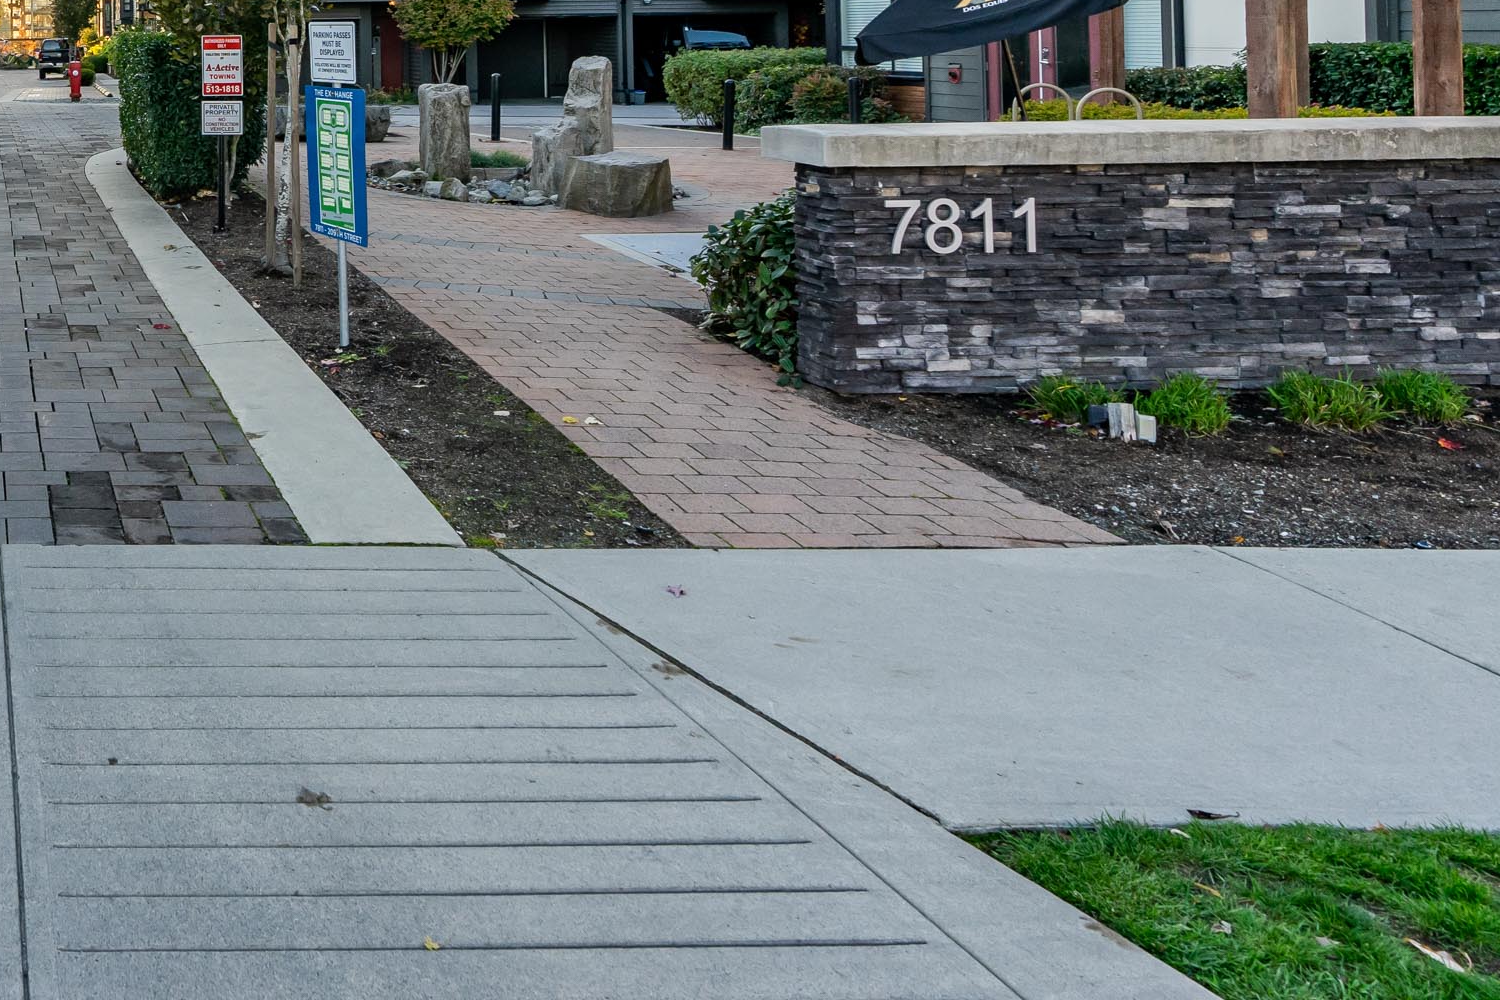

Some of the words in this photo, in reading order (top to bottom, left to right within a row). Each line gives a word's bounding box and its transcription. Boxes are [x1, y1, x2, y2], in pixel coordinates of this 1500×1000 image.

[963, 5, 981, 13] DOS
[313, 31, 332, 39] PARKING
[206, 85, 240, 93] 513-1818
[314, 89, 324, 97] THE
[884, 197, 1037, 255] 7811
[344, 232, 362, 243] STREET
